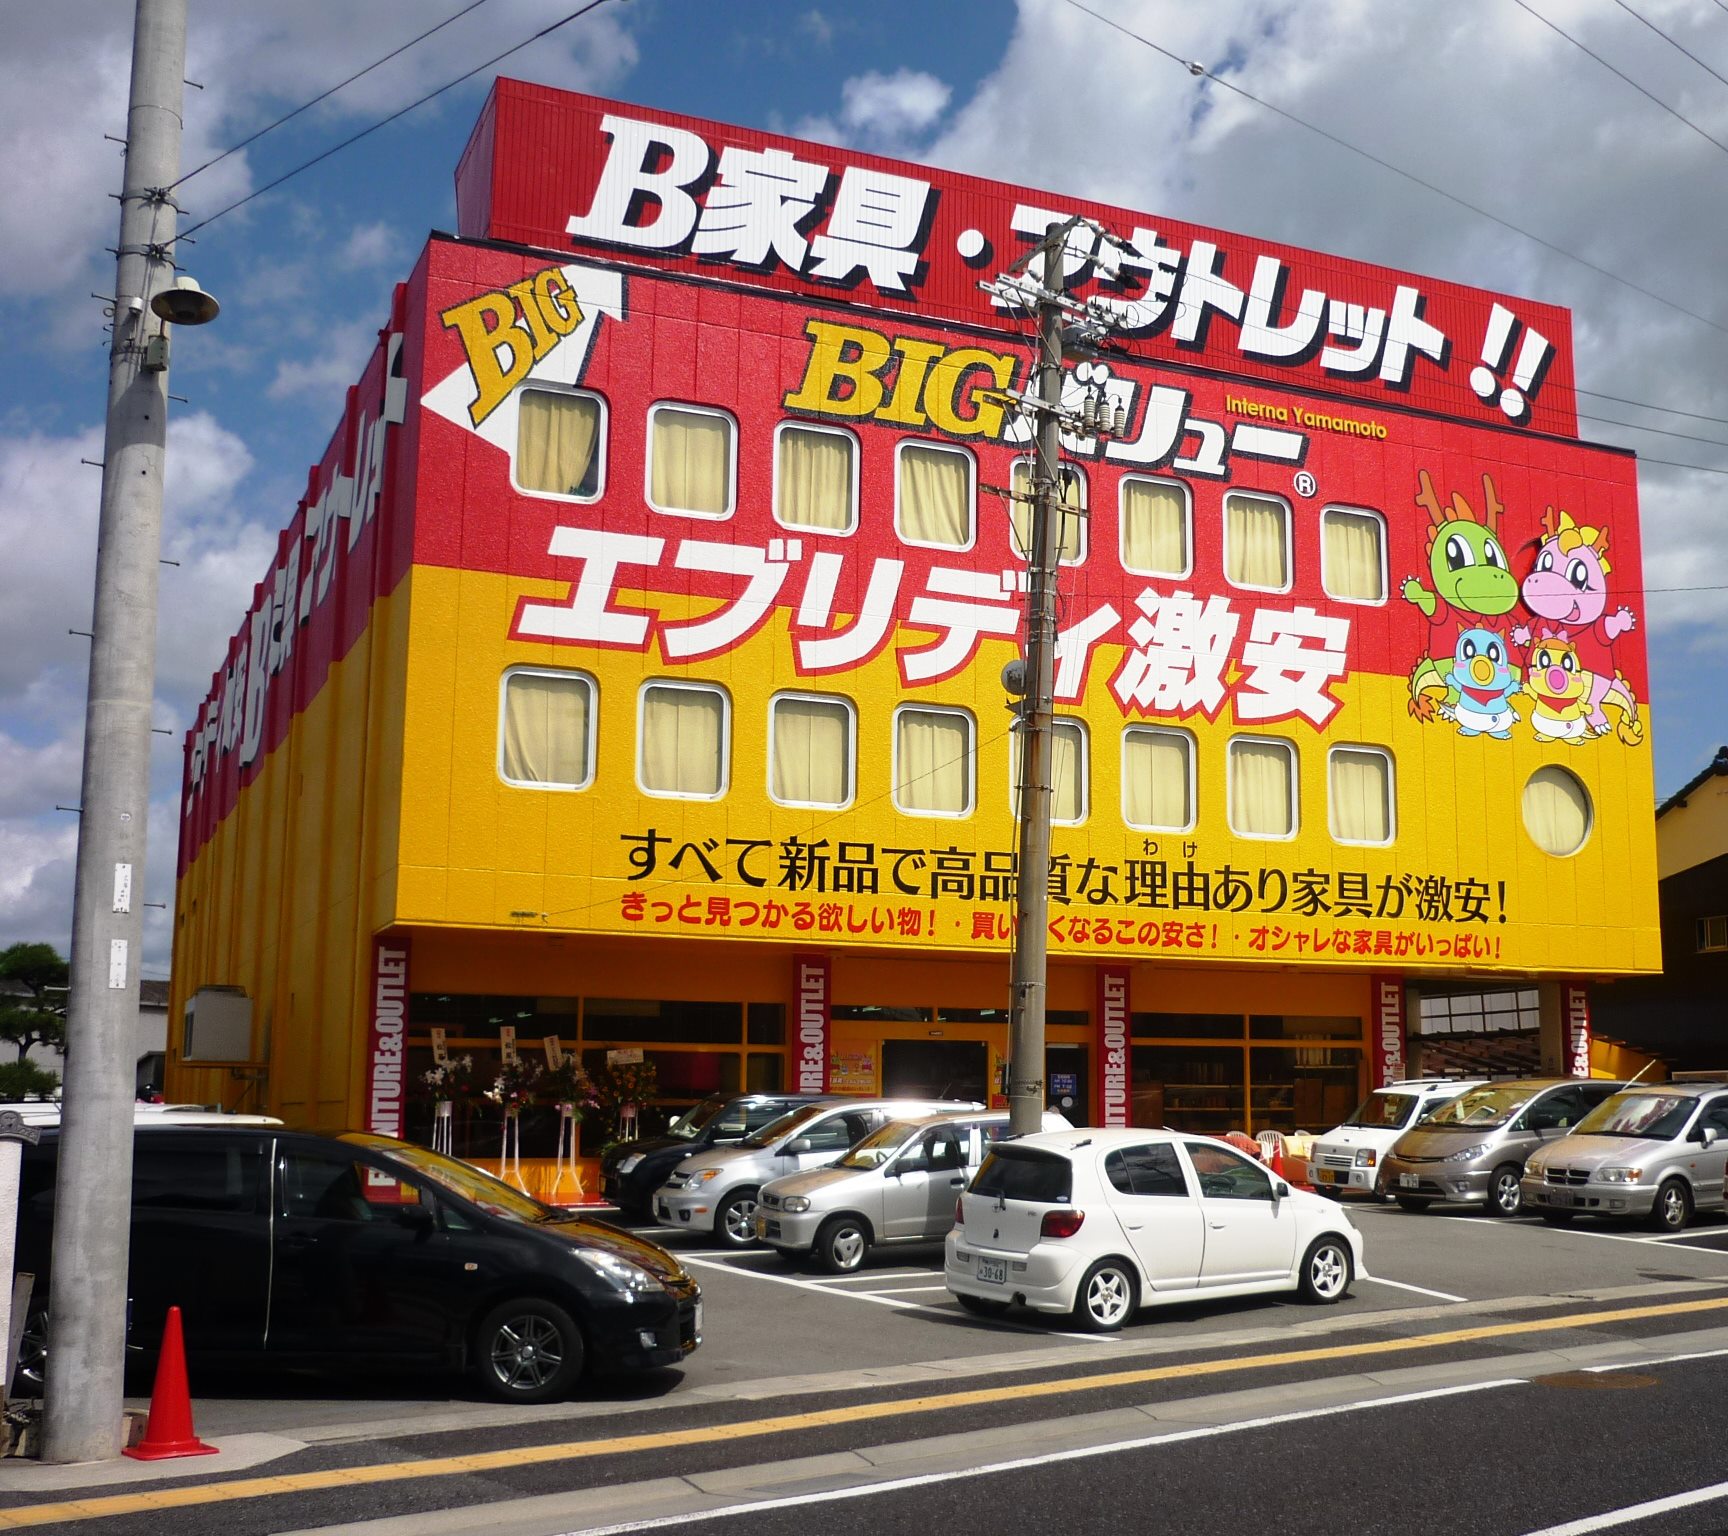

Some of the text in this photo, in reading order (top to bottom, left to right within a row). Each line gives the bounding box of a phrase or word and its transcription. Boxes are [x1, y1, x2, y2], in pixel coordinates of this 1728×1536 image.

[442, 267, 584, 430] BIG
[1225, 393, 1388, 441] Interna Yamamoto
[620, 891, 1502, 960] きっと見つかる欲しい物!・買いくなるこの安さ!・オシャレな家具がいっぱい!
[367, 946, 407, 1187] FNITURE&OUTLET
[1104, 974, 1126, 1129] ITURE&OUTLET
